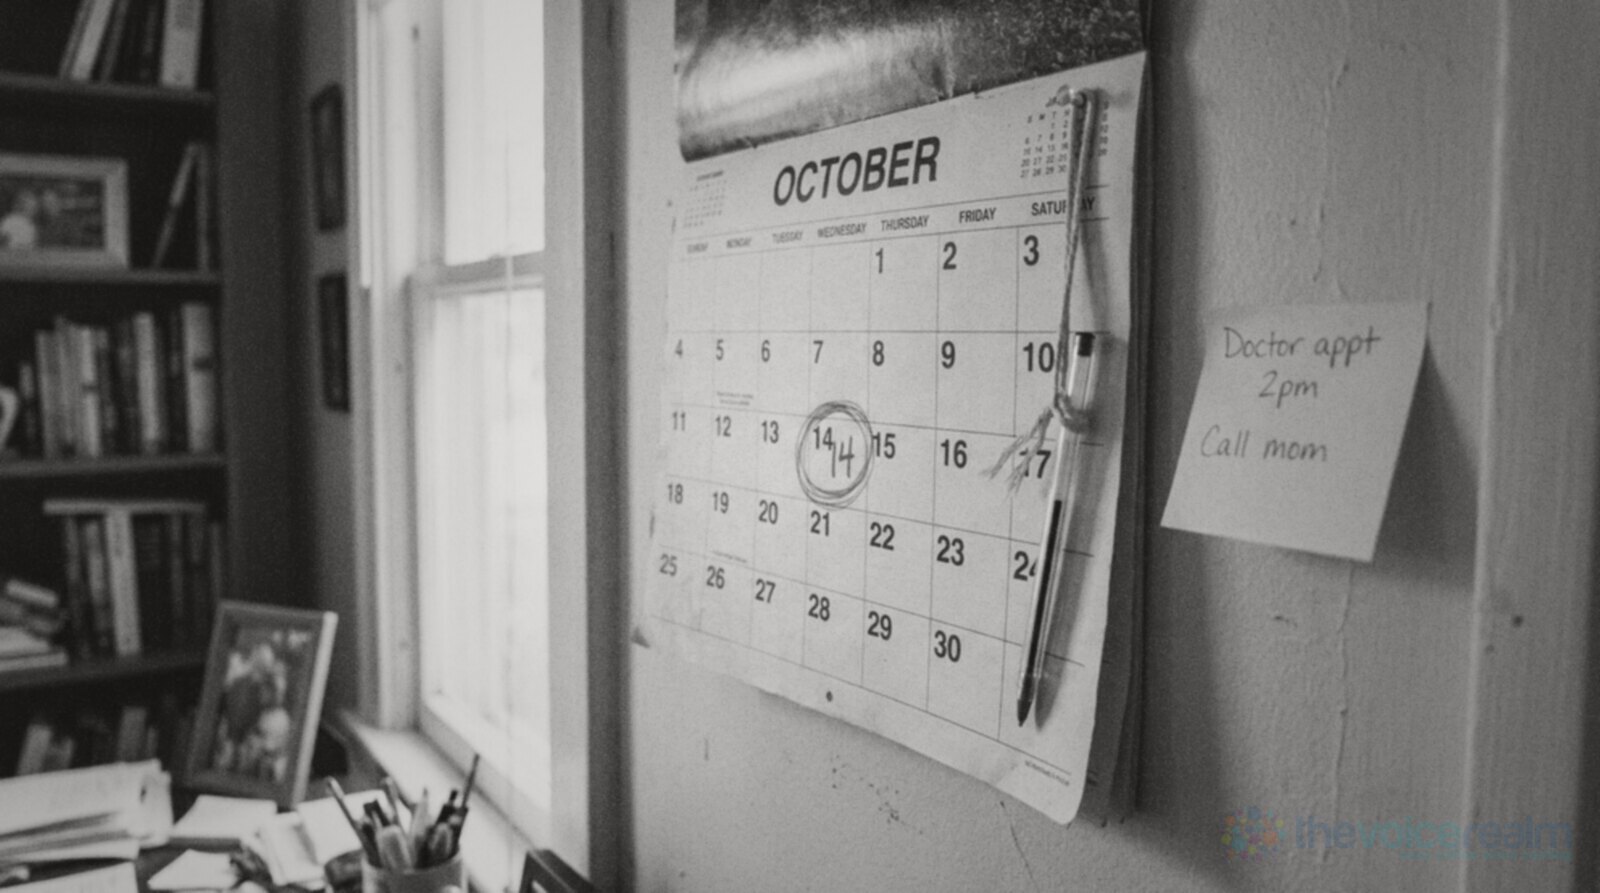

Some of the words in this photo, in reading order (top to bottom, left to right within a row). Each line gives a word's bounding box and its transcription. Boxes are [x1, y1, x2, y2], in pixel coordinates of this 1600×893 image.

[773, 136, 941, 207] OCTOBER
[817, 222, 867, 239] WEDNESDAY
[880, 215, 930, 232] THURSDAY
[958, 207, 997, 224] FRIDAY
[1031, 196, 1096, 217] SATURAY
[874, 247, 885, 274] 1
[942, 241, 958, 271] 2
[1022, 234, 1041, 267] 3
[674, 339, 684, 359] 4
[715, 338, 725, 361] 5
[760, 339, 771, 363] 6
[812, 340, 824, 364] 7
[872, 340, 886, 367] 8
[941, 340, 956, 369] 9
[1023, 341, 1055, 373] 10
[1223, 326, 1305, 360] Doctor
[1314, 325, 1381, 369] appt
[1258, 369, 1319, 409] 2pm
[672, 410, 686, 432] 11
[715, 415, 732, 437] 12
[761, 419, 780, 444] 13
[812, 426, 834, 451] 14
[872, 432, 896, 460] 15
[940, 438, 968, 469] 16
[1019, 448, 1051, 479] 17
[831, 435, 855, 479] 14
[1200, 423, 1250, 459] Call
[1262, 438, 1328, 462] mom
[668, 483, 684, 505] 18
[712, 491, 729, 514] 19
[758, 499, 779, 525] 20
[810, 509, 830, 537] 21
[869, 521, 895, 551] 22
[936, 534, 965, 567] 23
[659, 553, 678, 577] 25
[706, 565, 726, 590] 26
[755, 578, 776, 604] 27
[808, 593, 831, 622] 28
[867, 610, 893, 641] 29
[933, 629, 962, 663] 30
